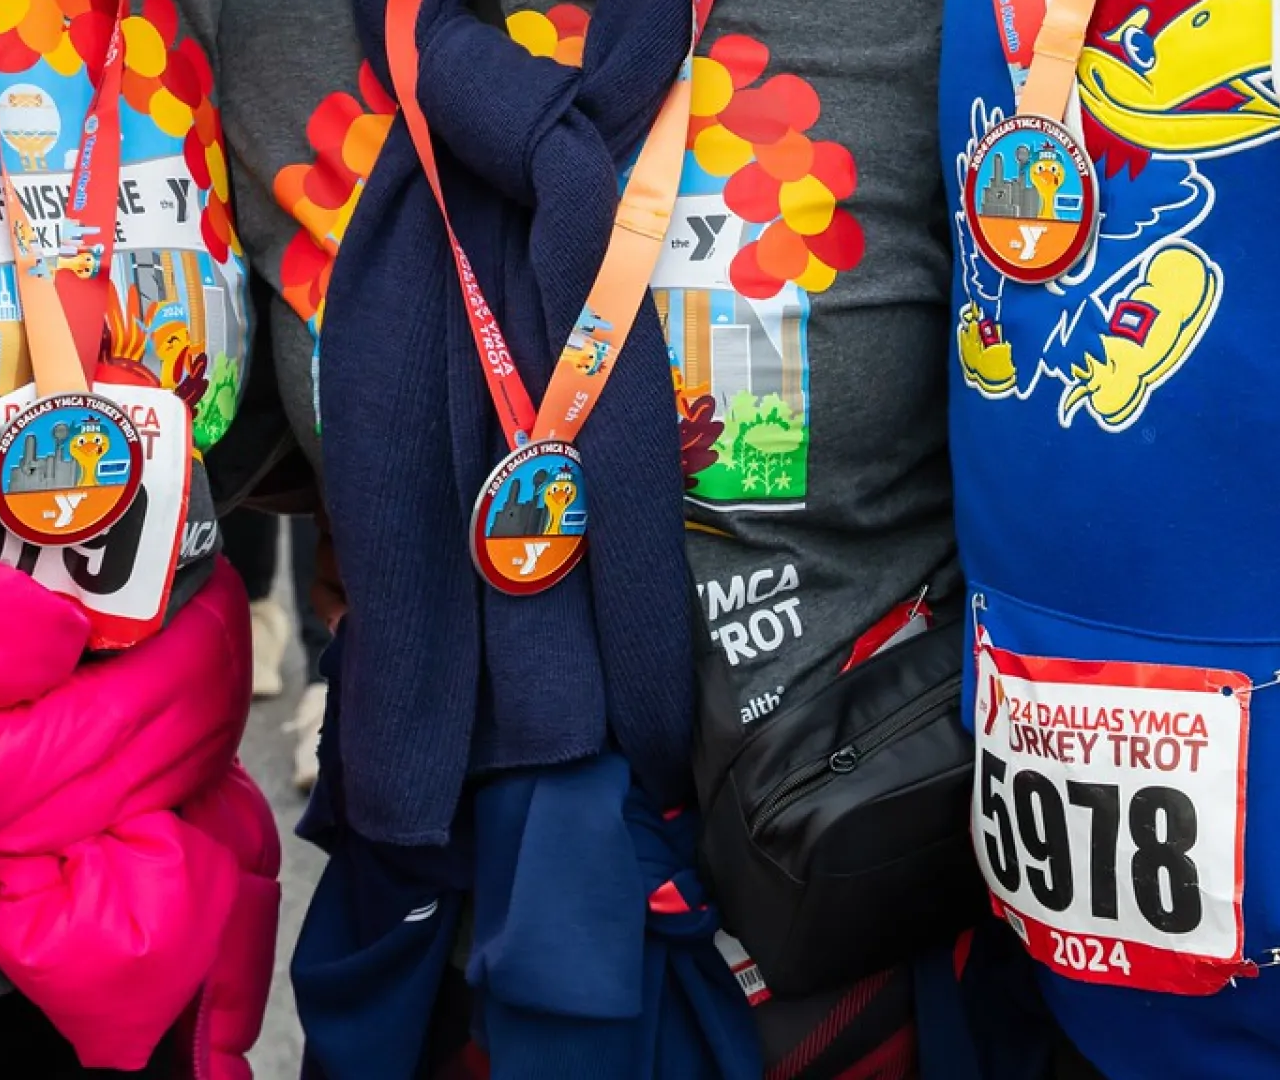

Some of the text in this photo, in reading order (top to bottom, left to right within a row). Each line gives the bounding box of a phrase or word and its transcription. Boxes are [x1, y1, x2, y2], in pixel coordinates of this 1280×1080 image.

[1016, 119, 1041, 129] YMCA
[1074, 148, 1090, 177] TROT
[480, 322, 506, 377] TROT
[489, 320, 515, 376] YMCA
[17, 401, 53, 428] DALLAS
[54, 396, 84, 408] YMCA
[86, 397, 122, 422] TURKEY
[565, 390, 589, 423] 57th
[696, 563, 800, 621] MCA
[710, 597, 803, 666] ROT
[1010, 697, 1208, 738] 24 DALLAS YMCA
[1009, 724, 1209, 773] URKEY TROT
[981, 748, 1204, 935] 5978
[1049, 930, 1131, 976] 2024
